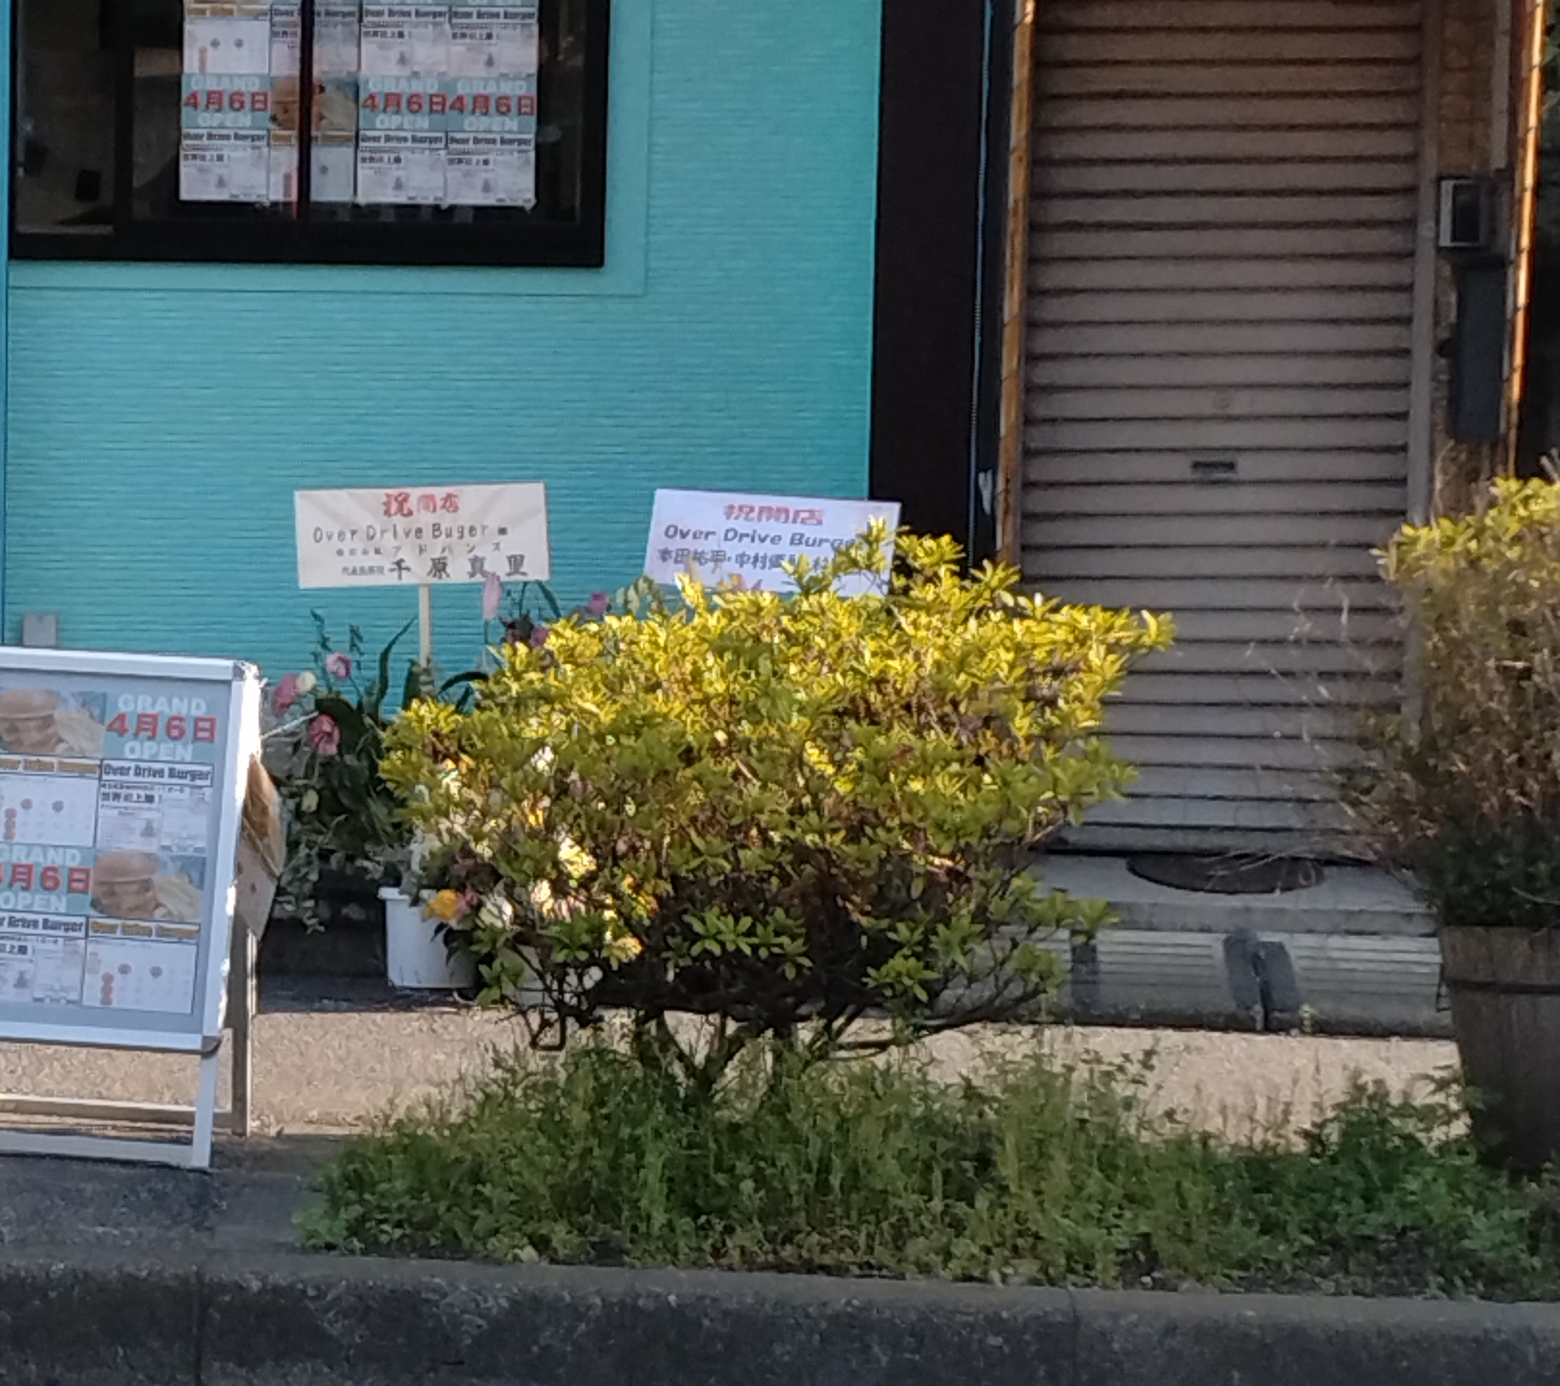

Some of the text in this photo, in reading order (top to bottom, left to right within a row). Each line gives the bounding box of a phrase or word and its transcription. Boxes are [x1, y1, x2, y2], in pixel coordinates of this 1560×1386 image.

[184, 89, 268, 112] 4月6日
[361, 92, 447, 114] 4月6日
[449, 94, 535, 115] 4月6日
[313, 525, 358, 543] Over
[366, 524, 424, 541] Drive
[432, 522, 488, 541] Buger
[664, 524, 718, 541] Over
[724, 527, 783, 546] Drive
[117, 693, 207, 715] GRAND
[106, 712, 218, 743] 4月6日
[124, 740, 192, 761] OPEN
